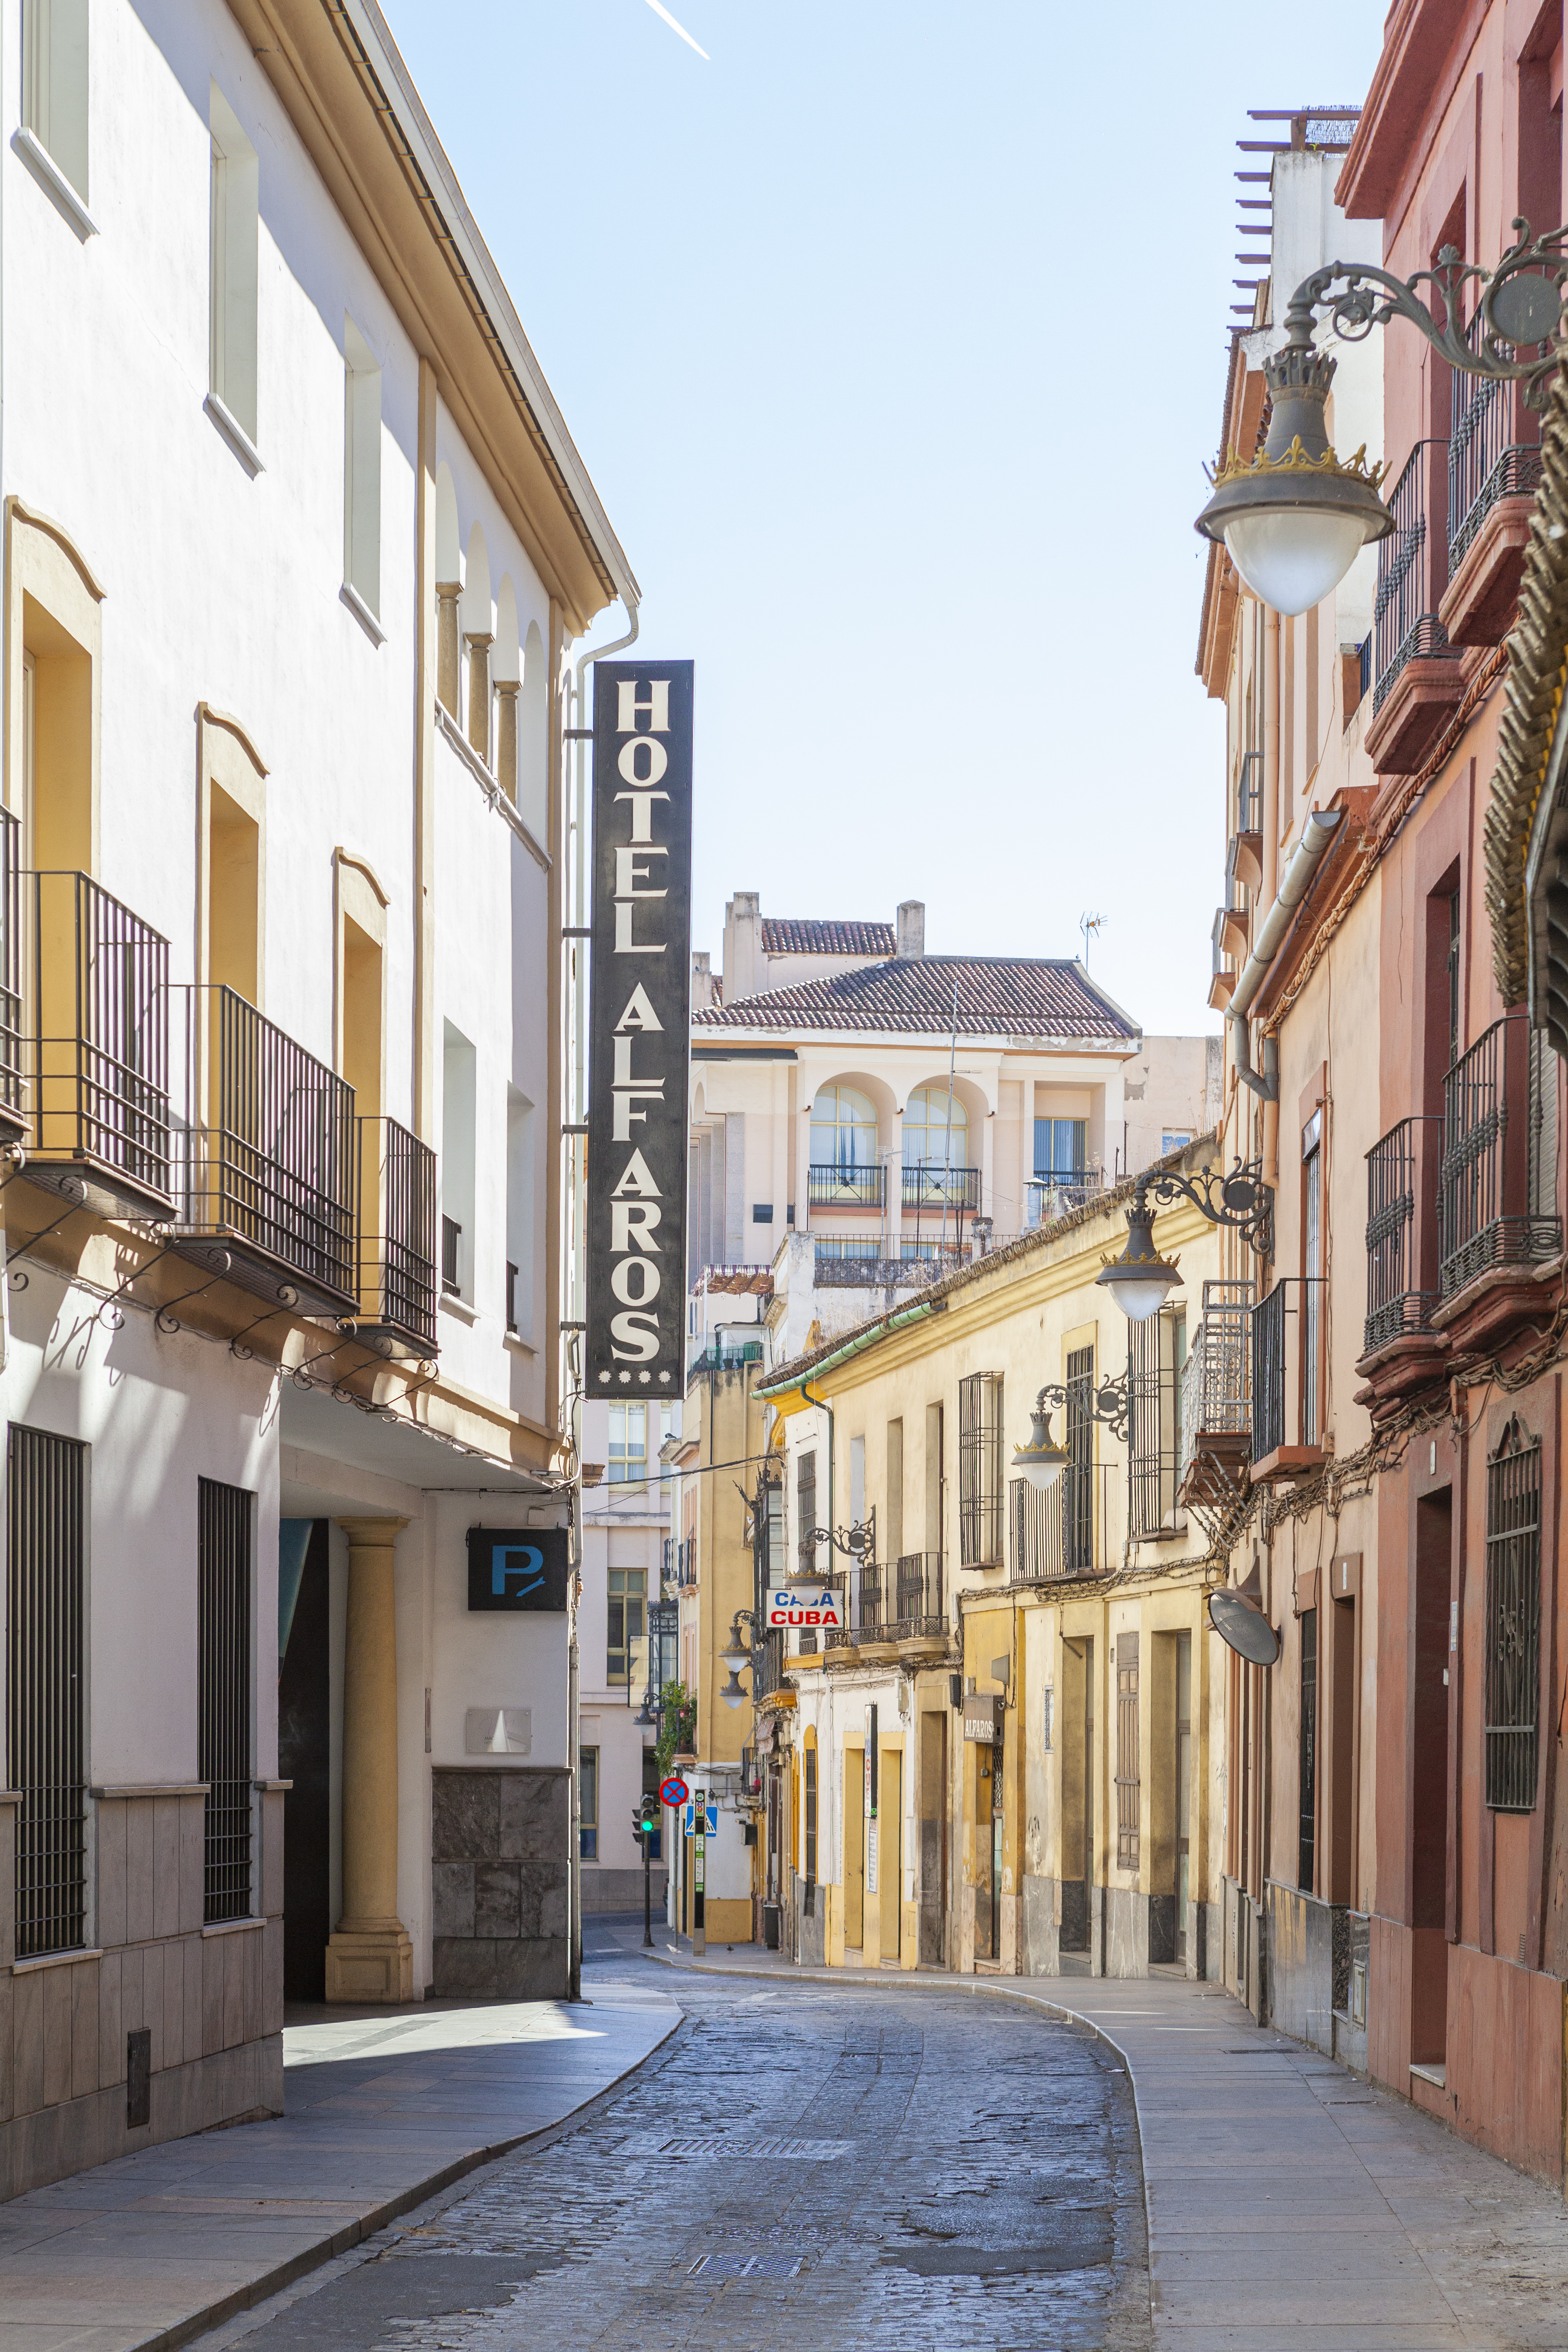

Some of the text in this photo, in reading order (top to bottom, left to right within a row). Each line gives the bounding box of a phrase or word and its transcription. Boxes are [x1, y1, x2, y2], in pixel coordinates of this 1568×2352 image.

[609, 680, 671, 1362] HOTEL ALFAROS
[492, 1545, 544, 1595] P
[770, 1610, 839, 1625] CUBA
[965, 1719, 993, 1739] ALFAROS
